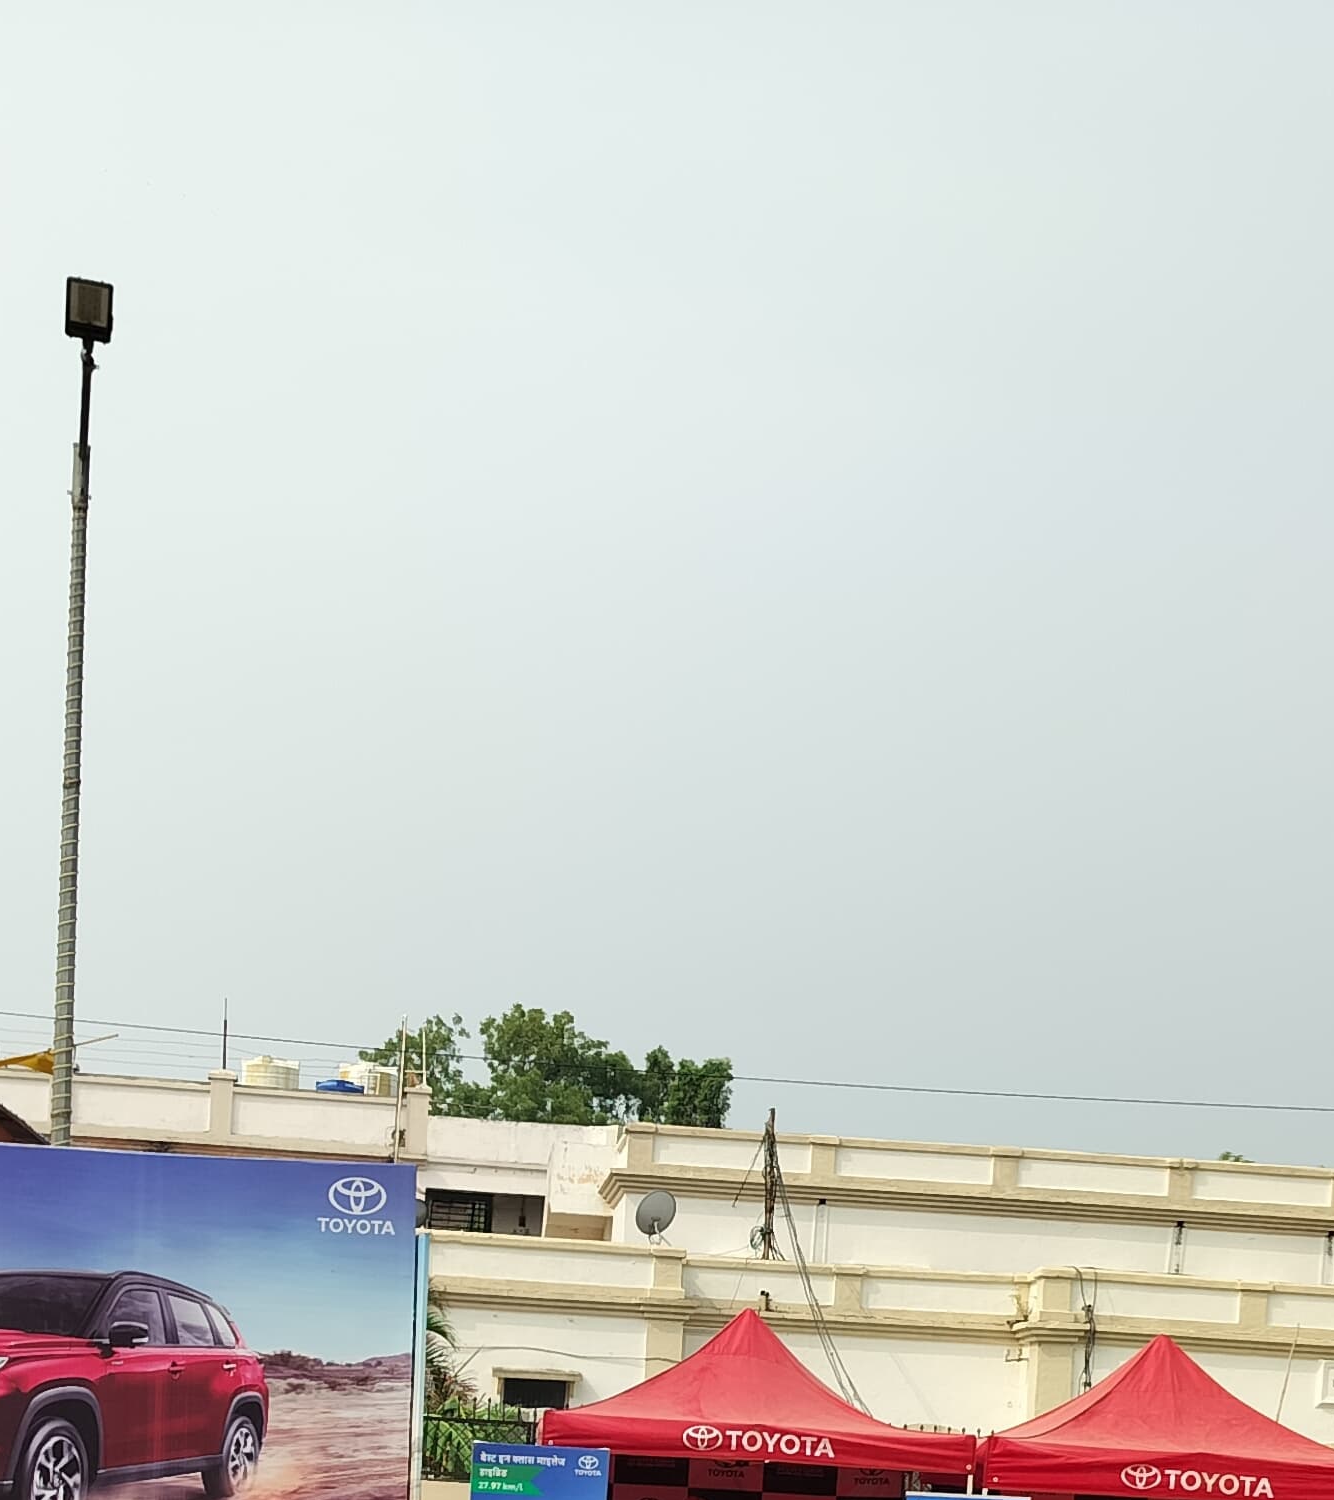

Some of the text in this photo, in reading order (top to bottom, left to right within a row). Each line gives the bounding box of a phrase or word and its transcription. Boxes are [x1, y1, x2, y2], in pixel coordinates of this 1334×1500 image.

[317, 1217, 395, 1235] TOYOTA
[725, 1430, 835, 1458] TOYOTA
[708, 1469, 745, 1479] TOYOTA
[478, 1481, 501, 1489] 27.97
[854, 1477, 891, 1486] TOYOTA
[1164, 1469, 1274, 1498] TOYOTA
